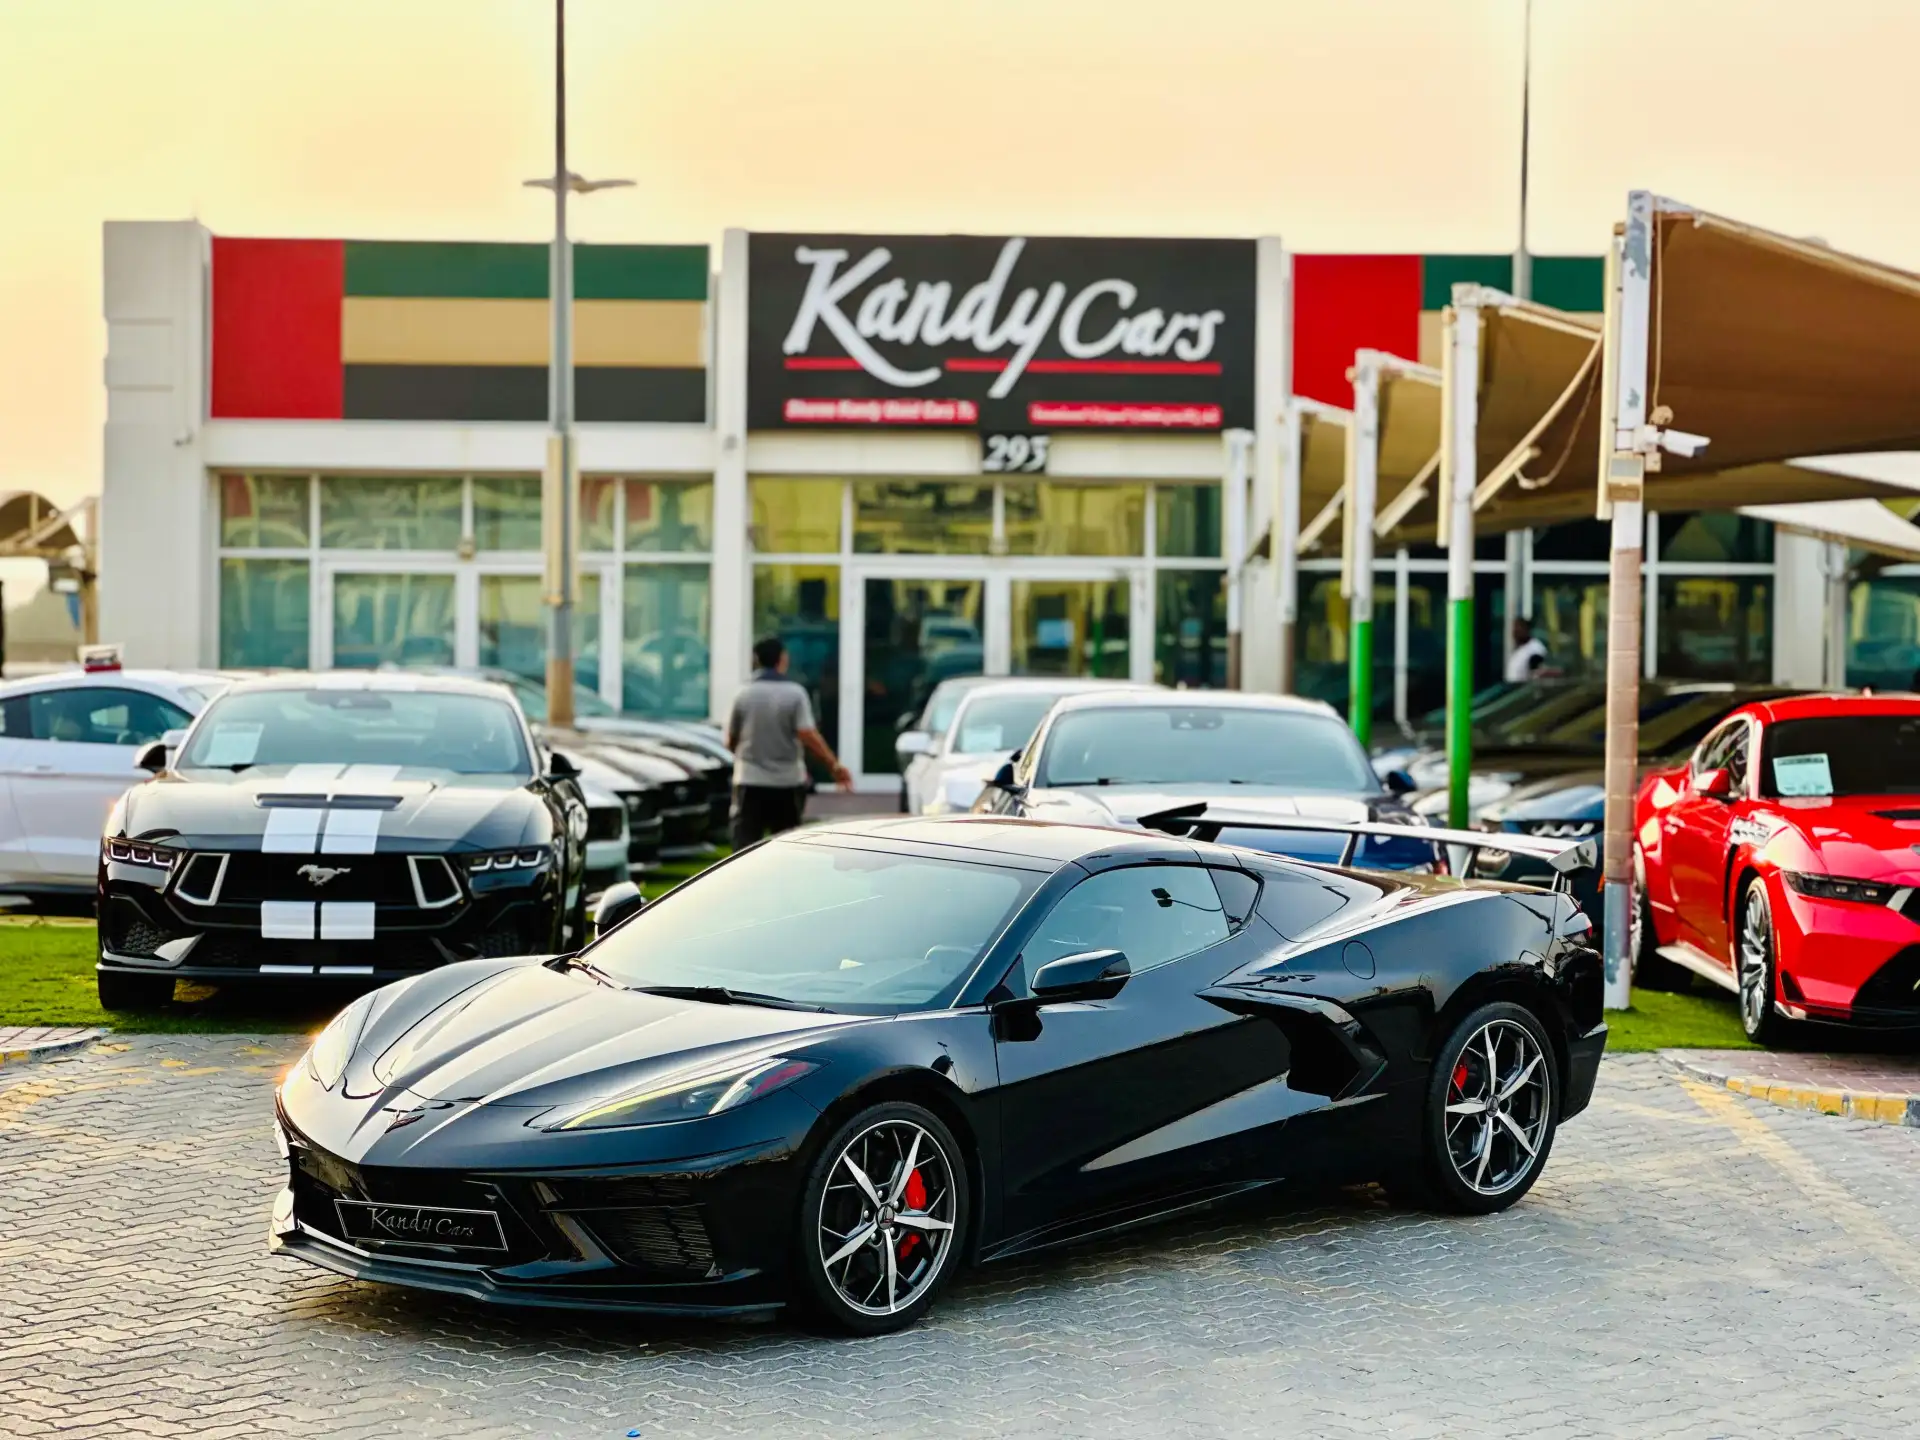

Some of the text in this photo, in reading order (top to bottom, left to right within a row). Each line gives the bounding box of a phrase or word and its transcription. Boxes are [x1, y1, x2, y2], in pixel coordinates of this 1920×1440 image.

[783, 236, 1225, 398] Kandy Cars
[983, 434, 1050, 472] 295
[366, 1207, 475, 1238] Kandy Cars
